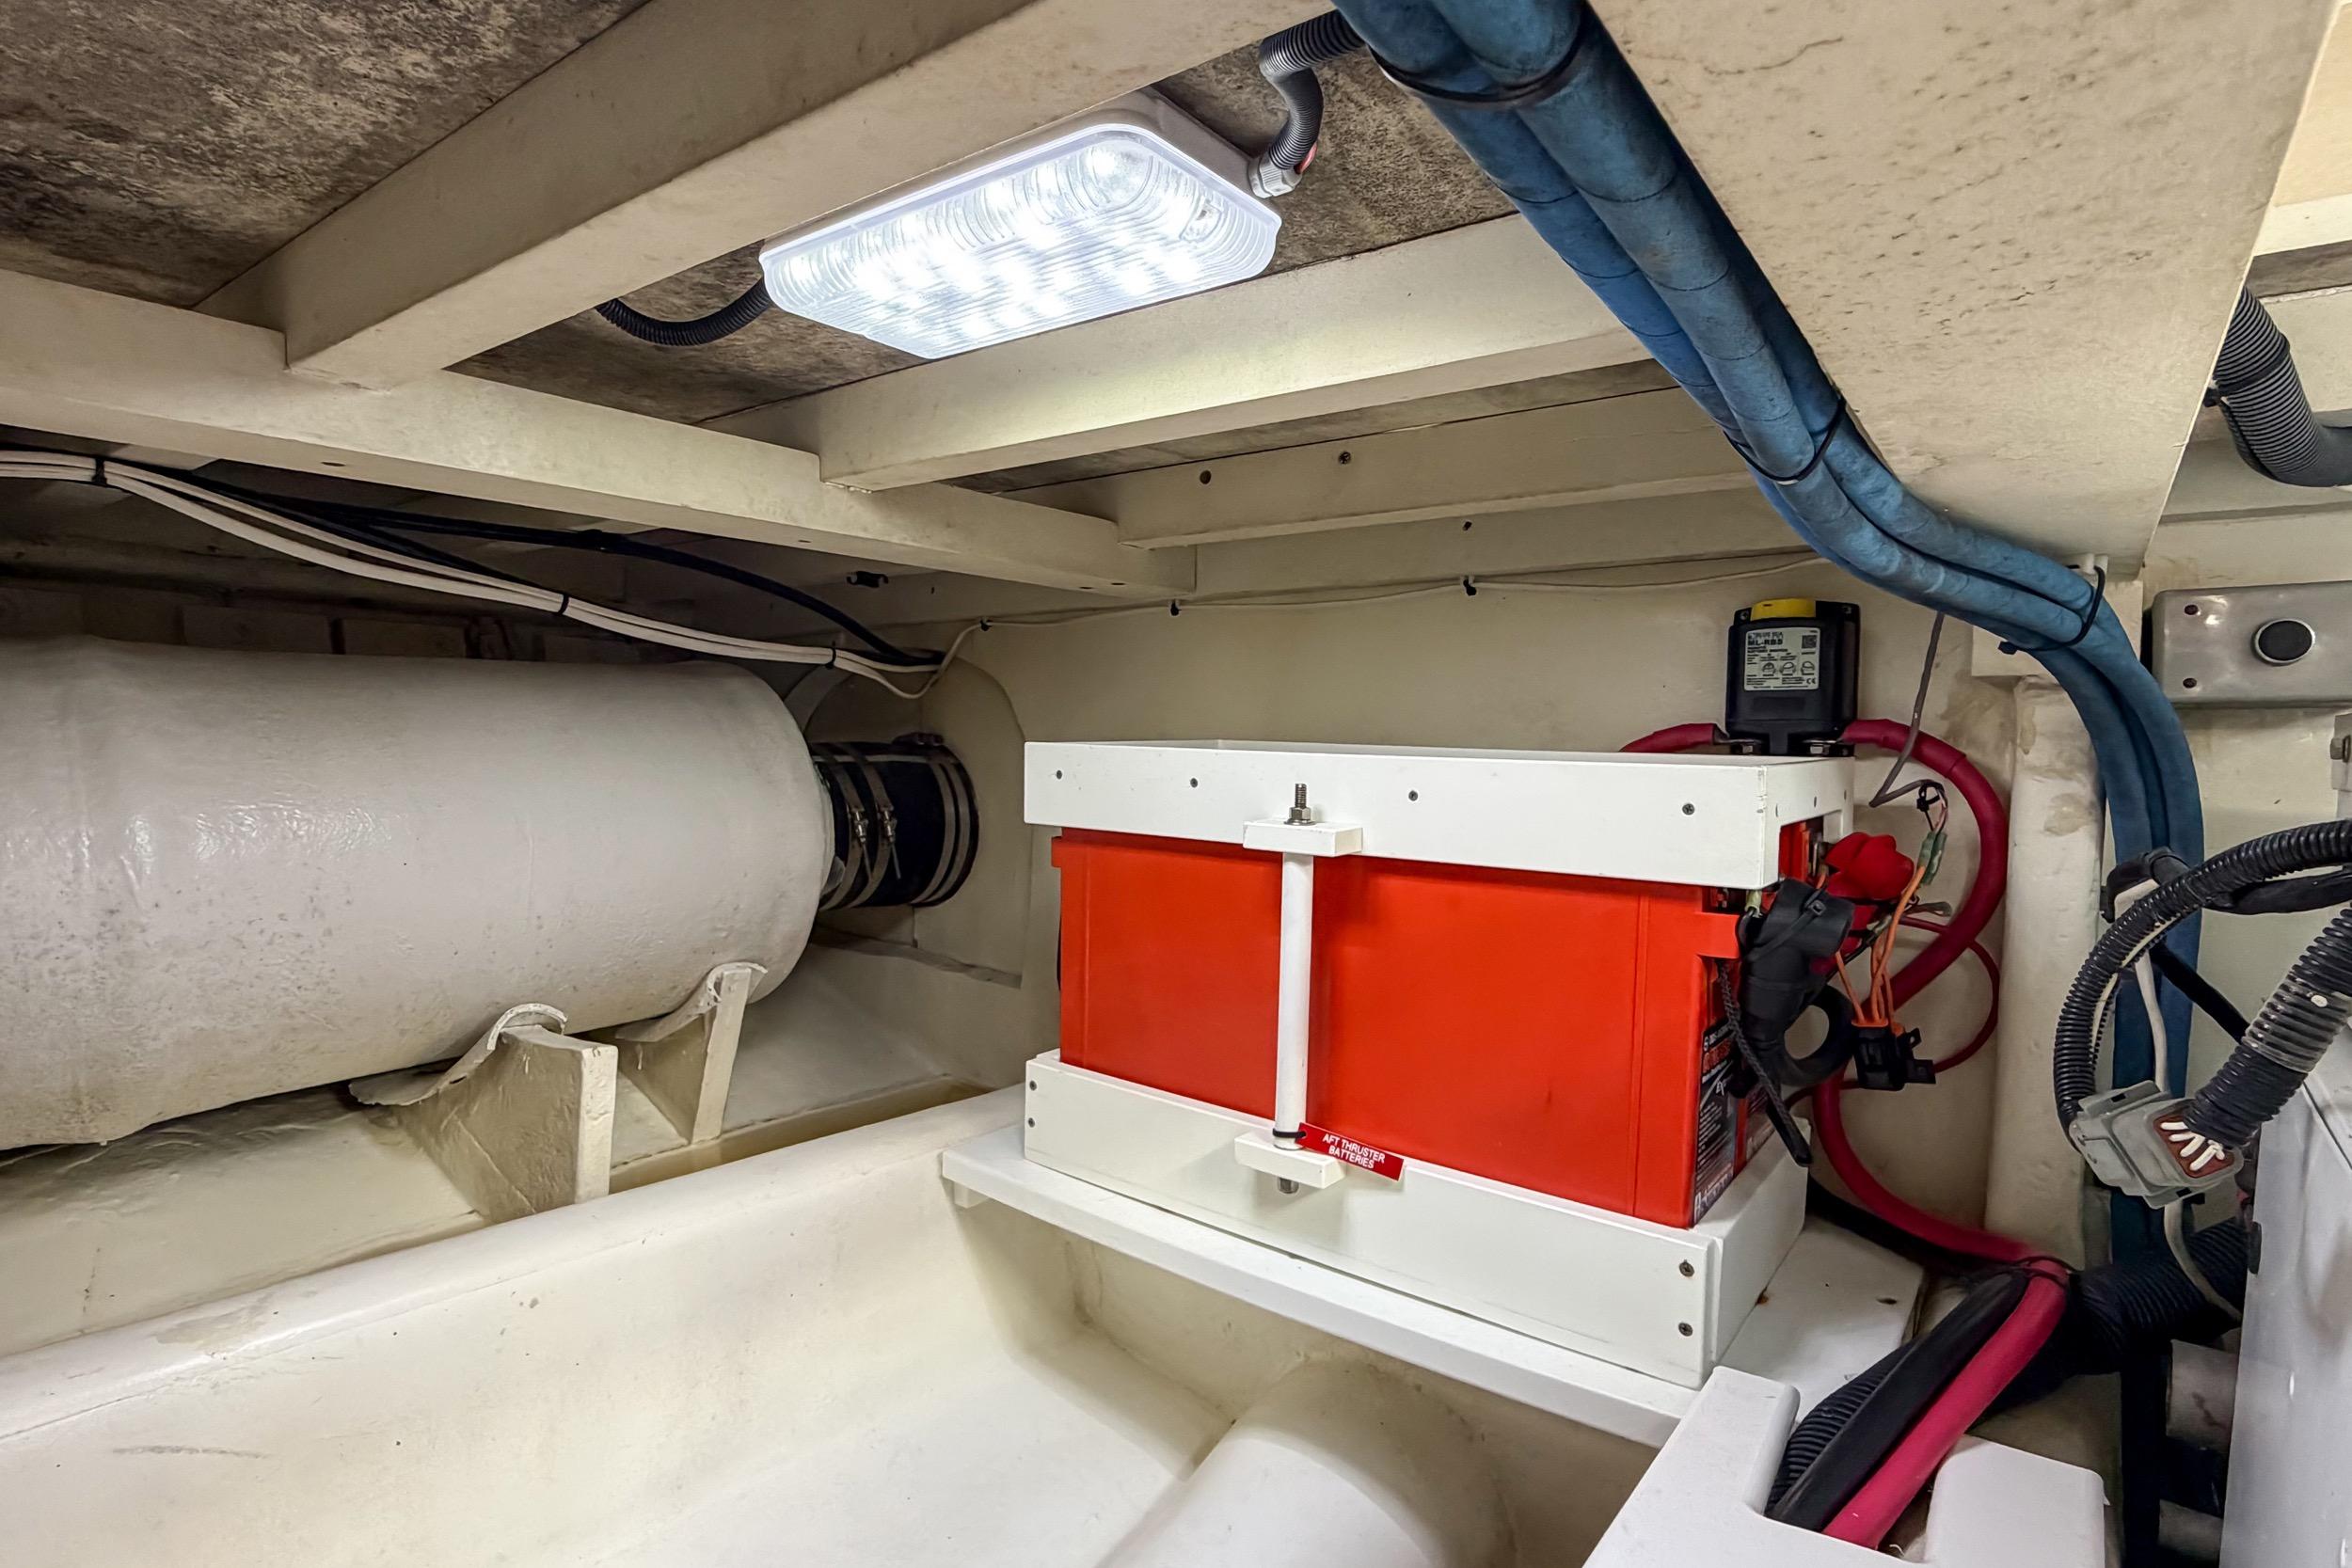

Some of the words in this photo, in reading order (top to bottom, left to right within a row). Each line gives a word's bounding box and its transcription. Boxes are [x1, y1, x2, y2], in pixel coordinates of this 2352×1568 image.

[1322, 1132, 1341, 1147] AFT
[1341, 1138, 1386, 1164] THRUSTER
[1328, 1145, 1375, 1169] BATTERIES
